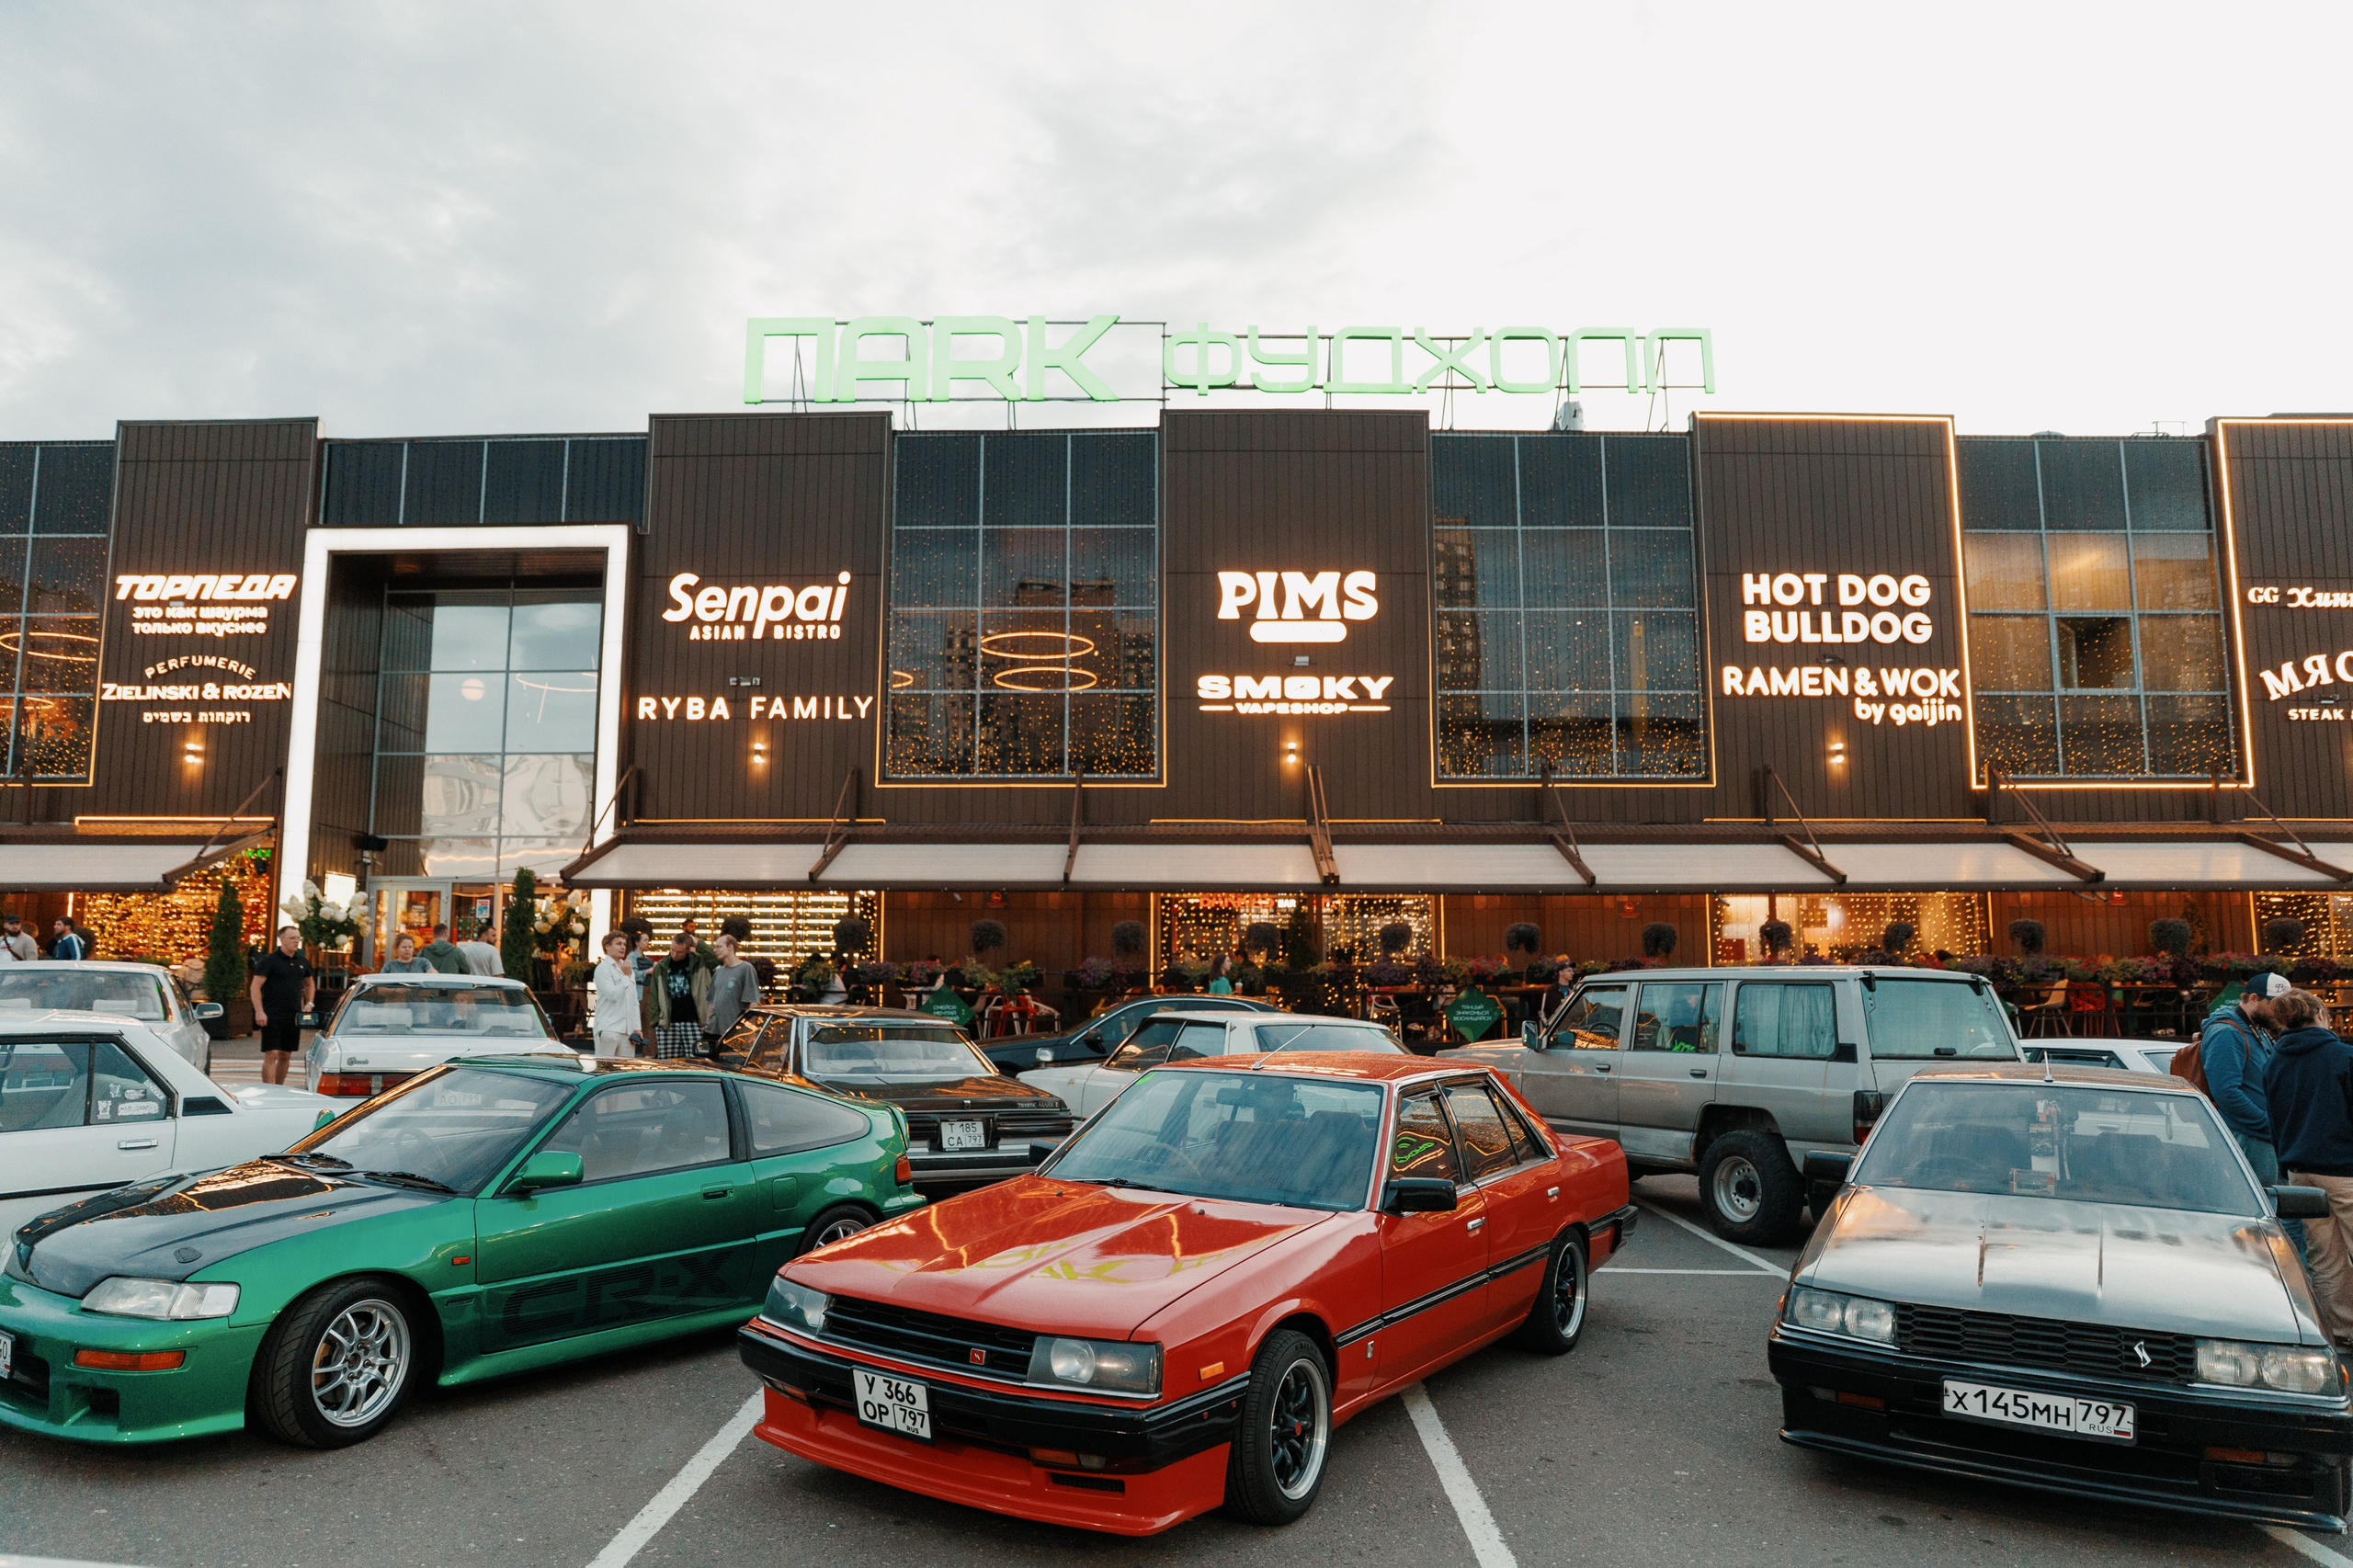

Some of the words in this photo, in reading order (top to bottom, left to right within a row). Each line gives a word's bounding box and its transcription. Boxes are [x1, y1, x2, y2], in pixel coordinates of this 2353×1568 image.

[1164, 322, 1715, 396] ФУДХОЛЛ
[116, 574, 297, 600] ТОРПЕДА
[1217, 570, 1379, 620] PIMS
[1742, 573, 1827, 606] HOT
[1838, 574, 1931, 607] DOG
[2287, 586, 2353, 608] Хин
[132, 607, 163, 619] это
[165, 607, 197, 619] как
[199, 607, 268, 620] шаурма
[662, 571, 851, 640] Senpai
[131, 622, 193, 634] только
[195, 622, 267, 637] вкуснее
[689, 625, 745, 640] ASIAN
[773, 624, 841, 640] BISTRO
[1744, 610, 1933, 644] BULLDOG
[144, 655, 256, 680] PERFUMERIE
[101, 683, 199, 700] ZIELINSKI
[201, 682, 220, 700] &
[222, 683, 291, 700] ROZEN
[1197, 675, 1394, 699] SMOKY
[638, 697, 730, 720] RYBA
[750, 696, 873, 720] FAMILY
[1235, 702, 1348, 714] VAPESHOP
[1854, 698, 1885, 725] by
[1889, 698, 1962, 726] gaijin
[2288, 709, 2345, 721] STEAK
[949, 1123, 955, 1133] Т
[959, 1122, 977, 1133] 185
[948, 1136, 963, 1147] СА
[967, 1135, 982, 1144] 797
[864, 1374, 876, 1394] У
[882, 1379, 917, 1405] 366
[863, 1400, 889, 1423] ОР
[899, 1407, 926, 1428] 797
[2078, 1402, 2127, 1426] 797
[906, 1426, 920, 1435] RUS
[2088, 1424, 2113, 1434] RUS
